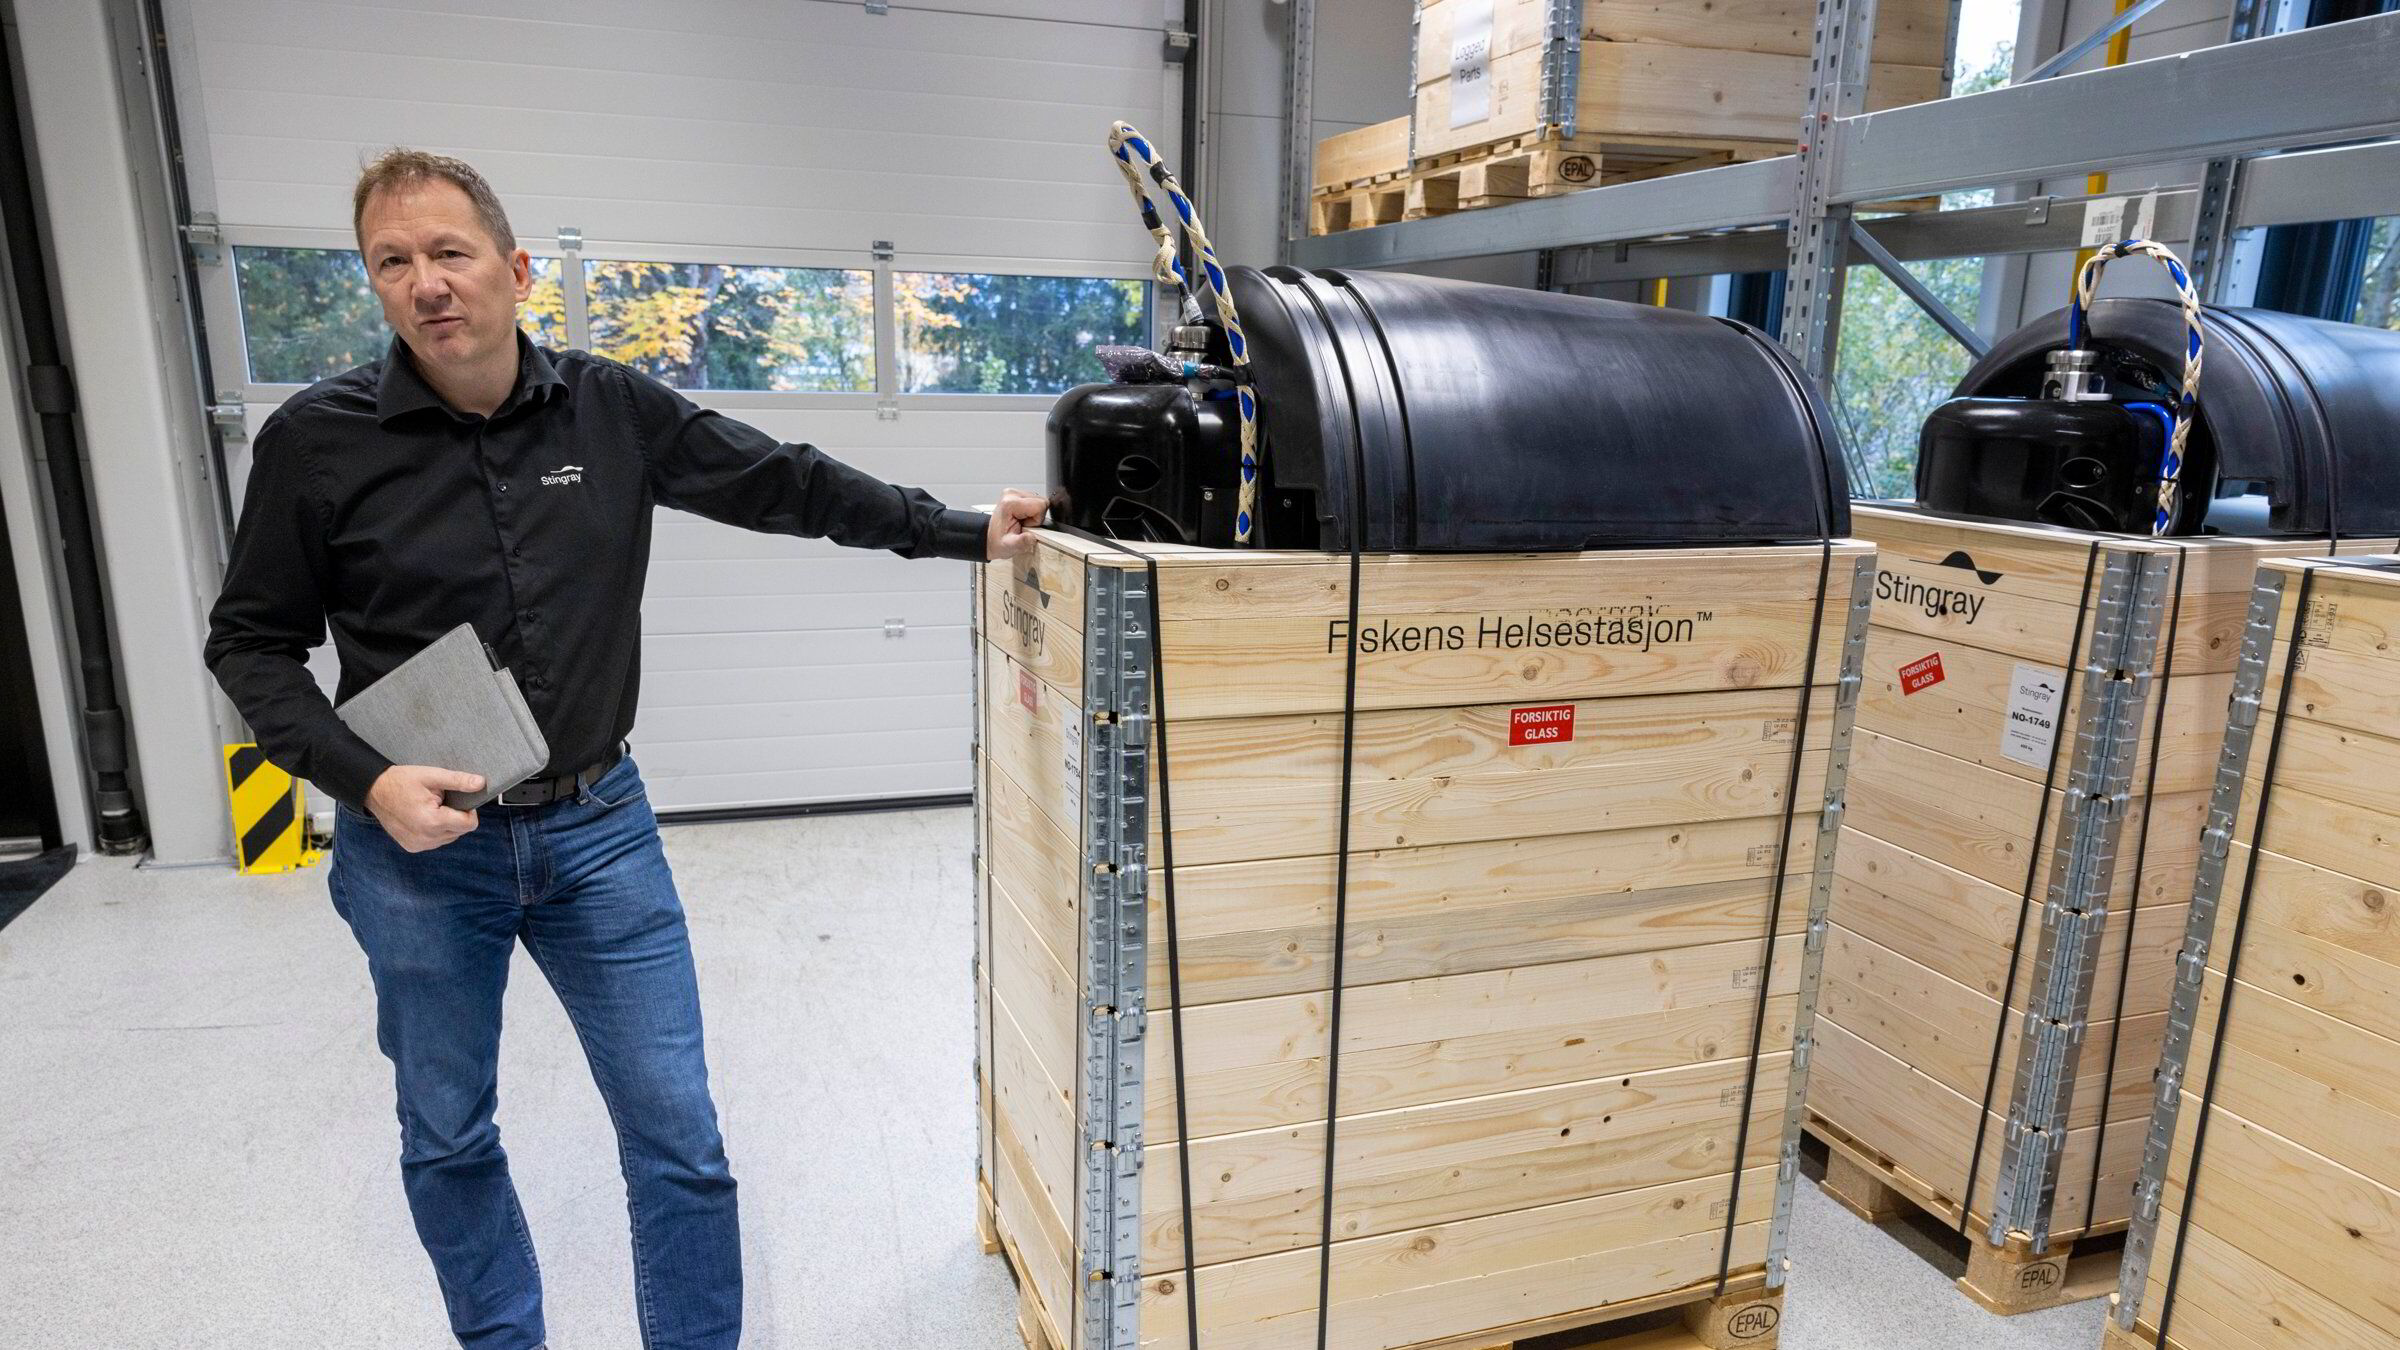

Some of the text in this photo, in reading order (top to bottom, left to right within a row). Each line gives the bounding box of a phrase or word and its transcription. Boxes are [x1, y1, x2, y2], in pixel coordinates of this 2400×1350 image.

[1455, 39, 1485, 61] Logged
[1460, 66, 1481, 84] Parts
[1564, 162, 1590, 177] EPAL
[541, 473, 581, 485] Stingray
[1876, 570, 1985, 625] Stingray
[1002, 589, 1045, 656] Stingray
[1328, 619, 1464, 653] Fskens
[1901, 656, 1939, 679] FORSIKTIG
[1911, 672, 1935, 689] GLASS
[2019, 685, 2051, 703] Stingray
[1514, 709, 1571, 724] FORSIKTIG
[2012, 711, 2051, 729] NO-1749
[1525, 727, 1558, 740] GLASS
[2021, 1268, 2052, 1289] EPAL
[1735, 1311, 1771, 1333] EPAL
